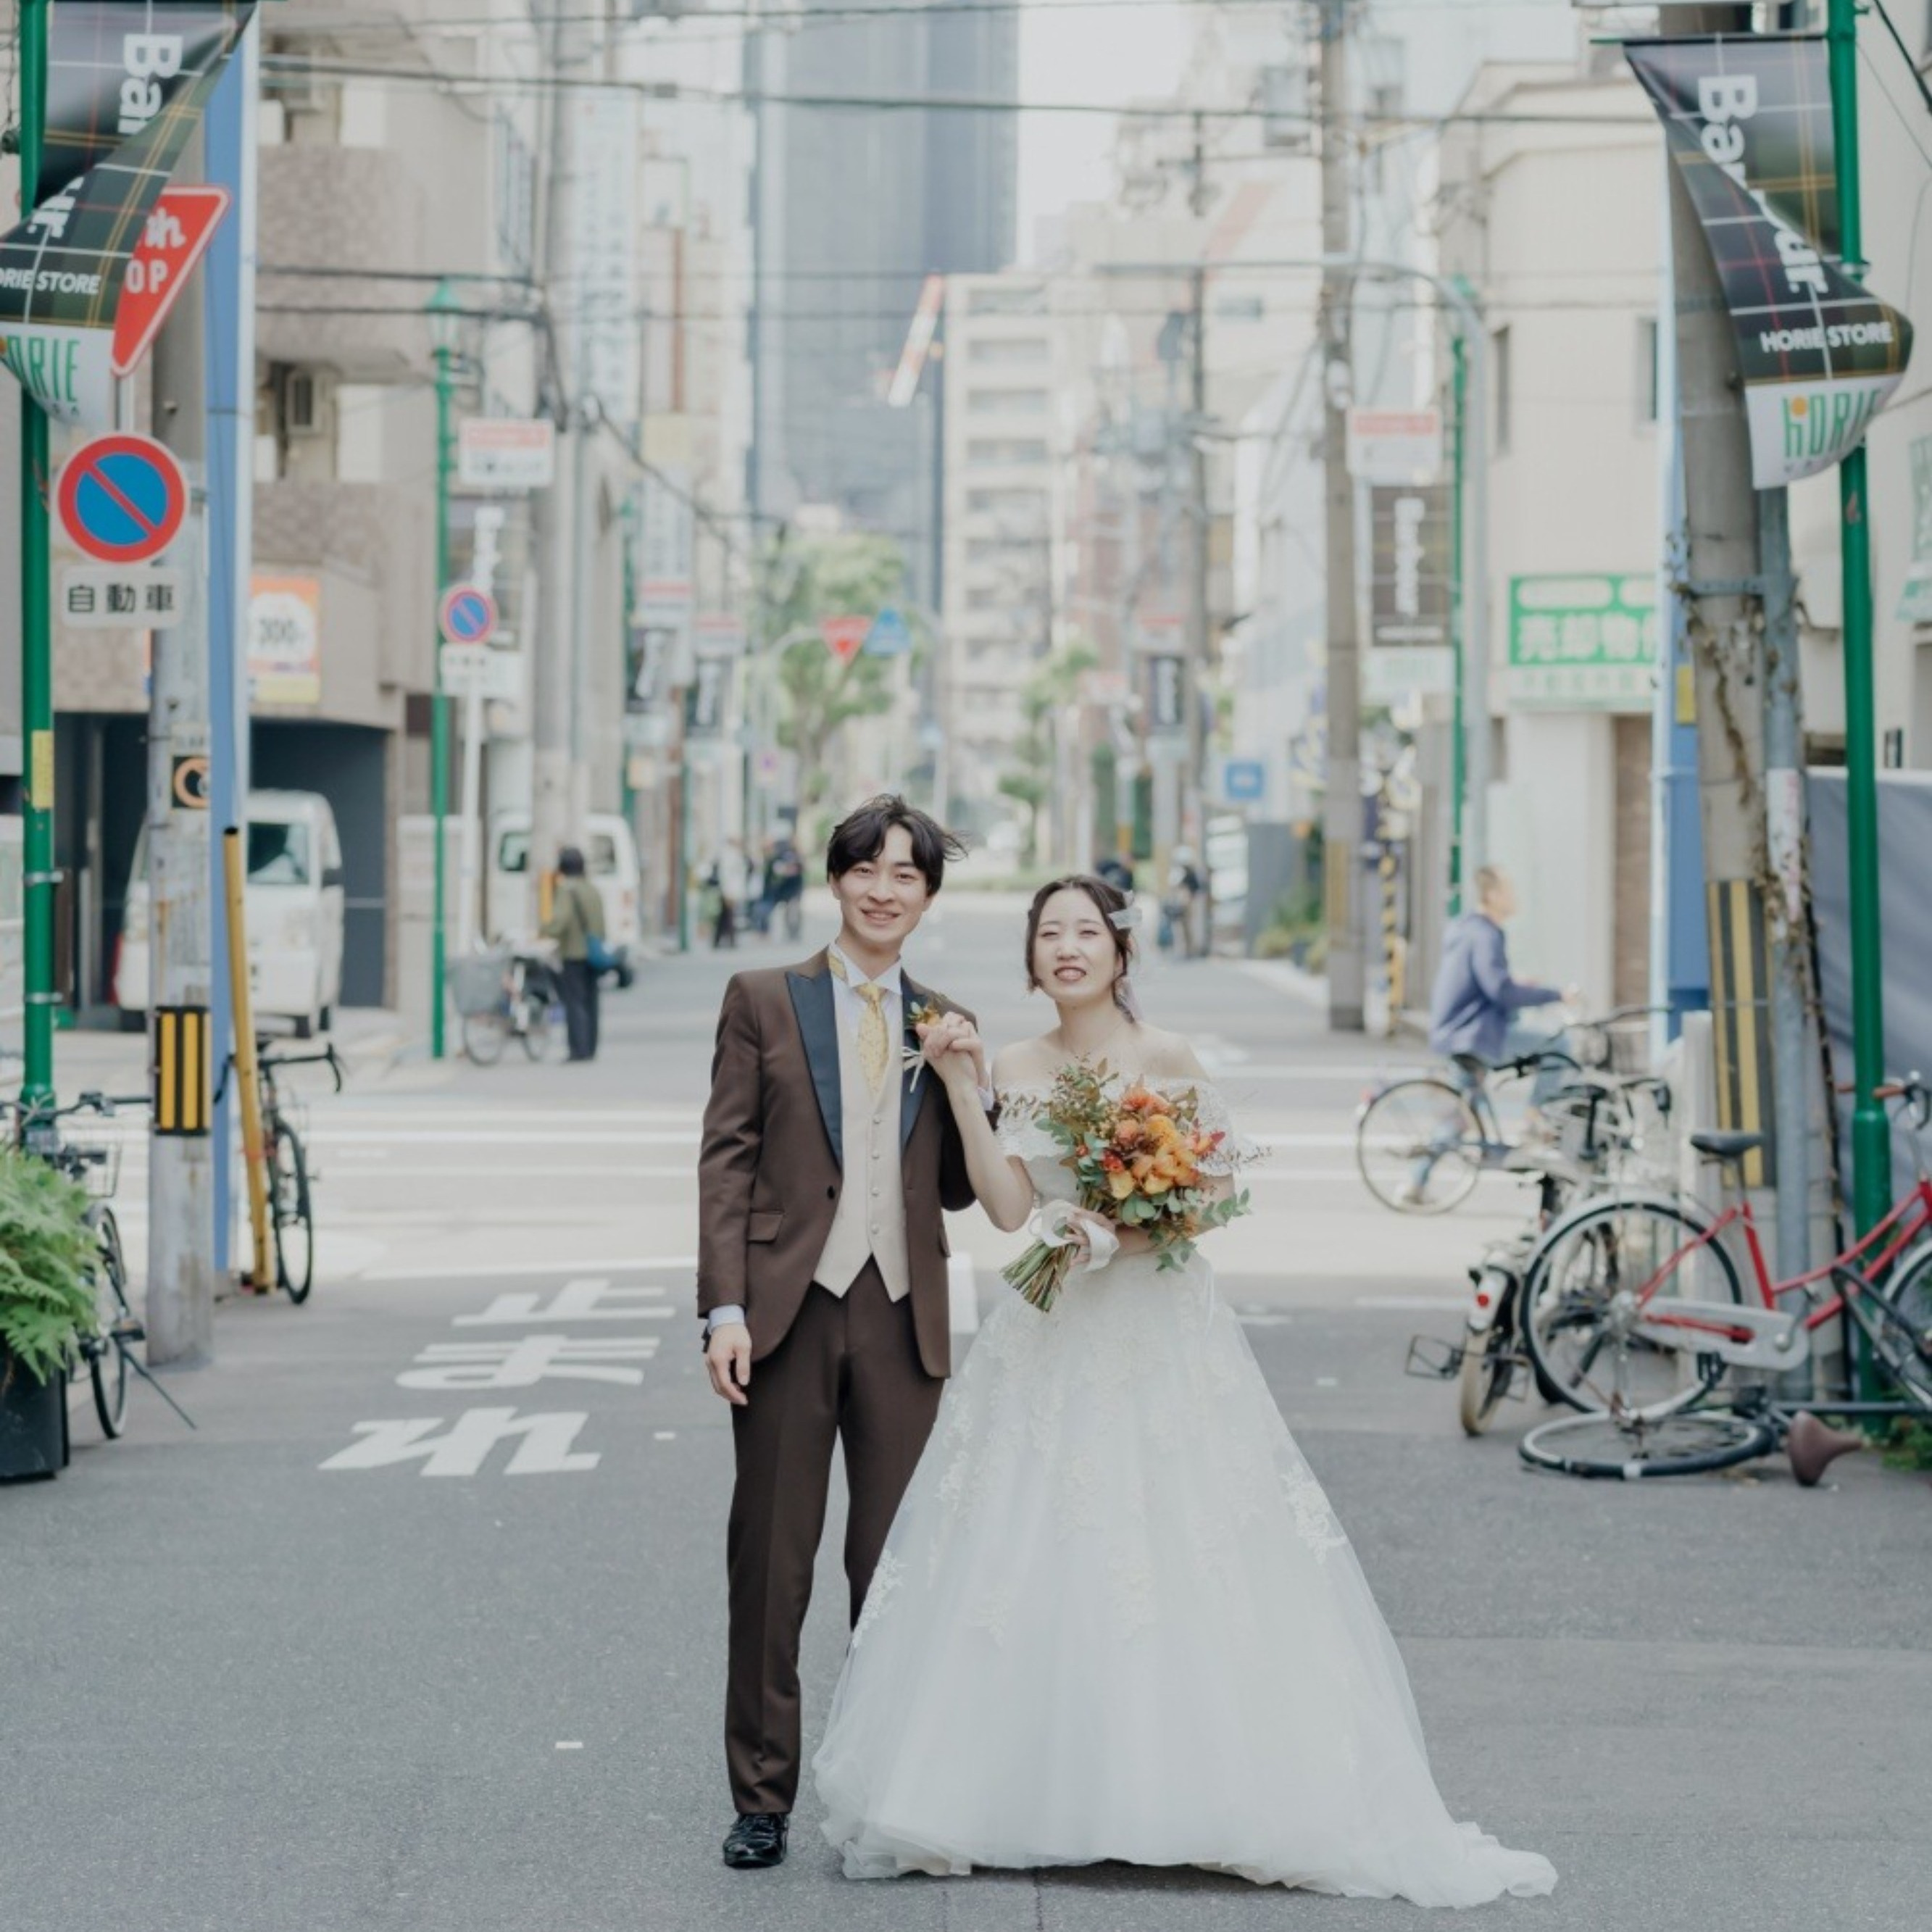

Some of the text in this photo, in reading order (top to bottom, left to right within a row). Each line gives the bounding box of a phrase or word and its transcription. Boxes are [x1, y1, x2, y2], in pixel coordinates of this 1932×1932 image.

[36, 270, 101, 295] STORE
[1760, 321, 1894, 354] HORIE STORE
[68, 584, 175, 614] 自動車
[317, 1279, 676, 1477] 止まれ
